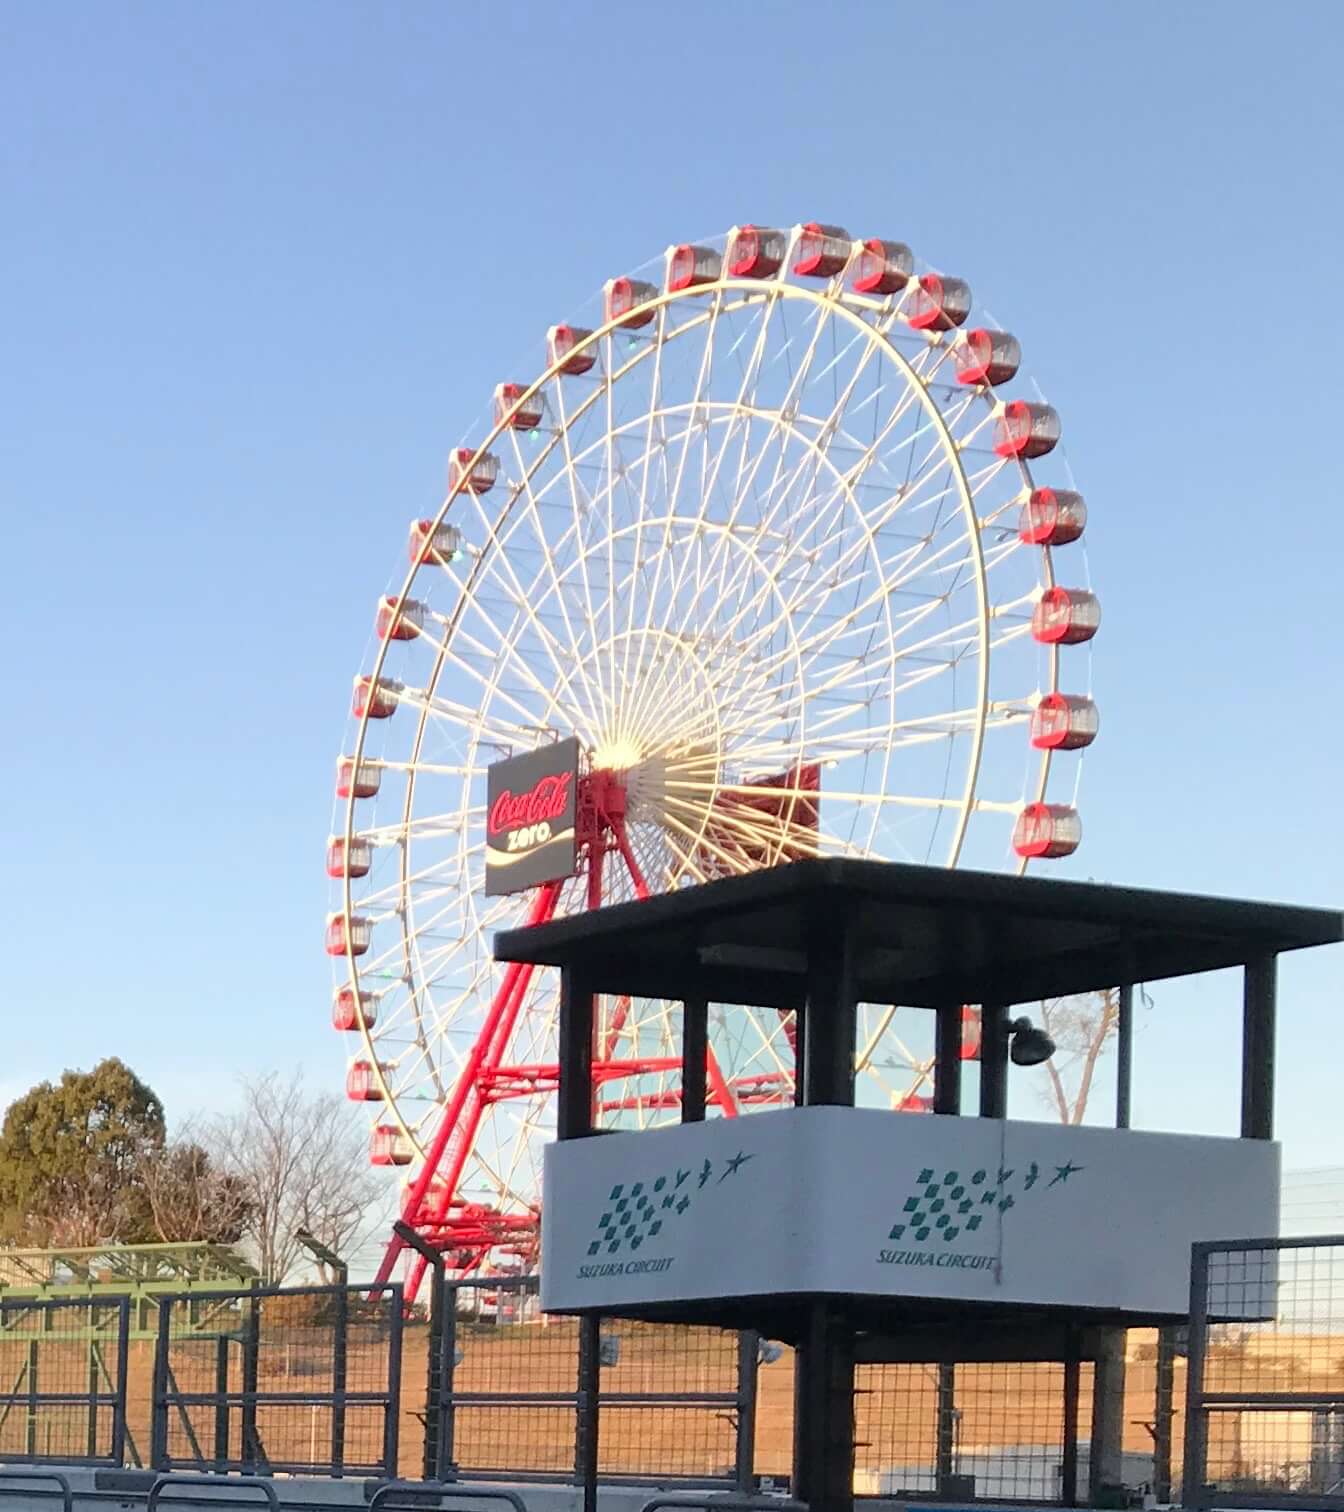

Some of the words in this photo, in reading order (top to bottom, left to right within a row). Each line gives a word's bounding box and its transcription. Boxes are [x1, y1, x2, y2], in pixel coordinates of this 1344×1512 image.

[489, 772, 572, 835] Coca-Cola
[576, 1262, 623, 1279] SUZUKA
[625, 1258, 674, 1274] CIRCUIT
[876, 1249, 934, 1266] SUZUKA
[937, 1252, 999, 1270] CIRCUIT
